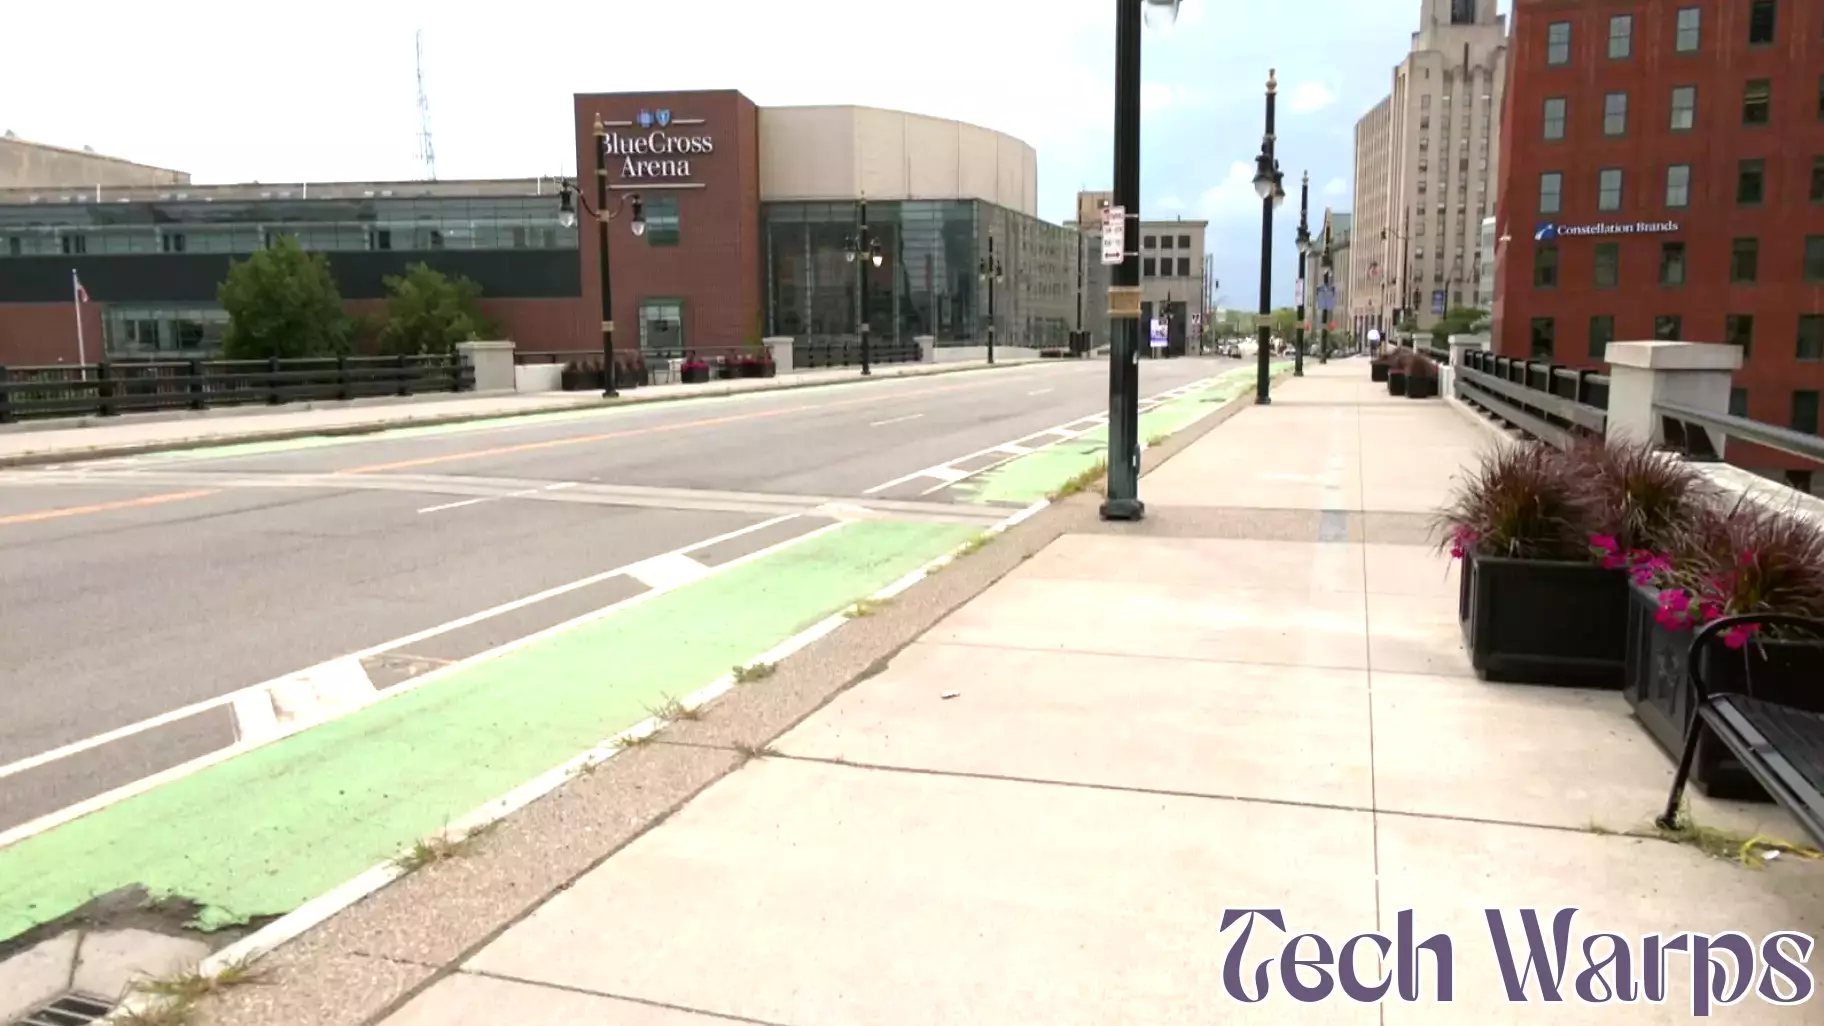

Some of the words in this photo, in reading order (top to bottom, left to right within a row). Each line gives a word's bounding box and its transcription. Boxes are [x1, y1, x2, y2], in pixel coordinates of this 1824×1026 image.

[621, 156, 691, 177] Arena
[1557, 222, 1633, 236] Constellation
[1636, 221, 1678, 233] Brands
